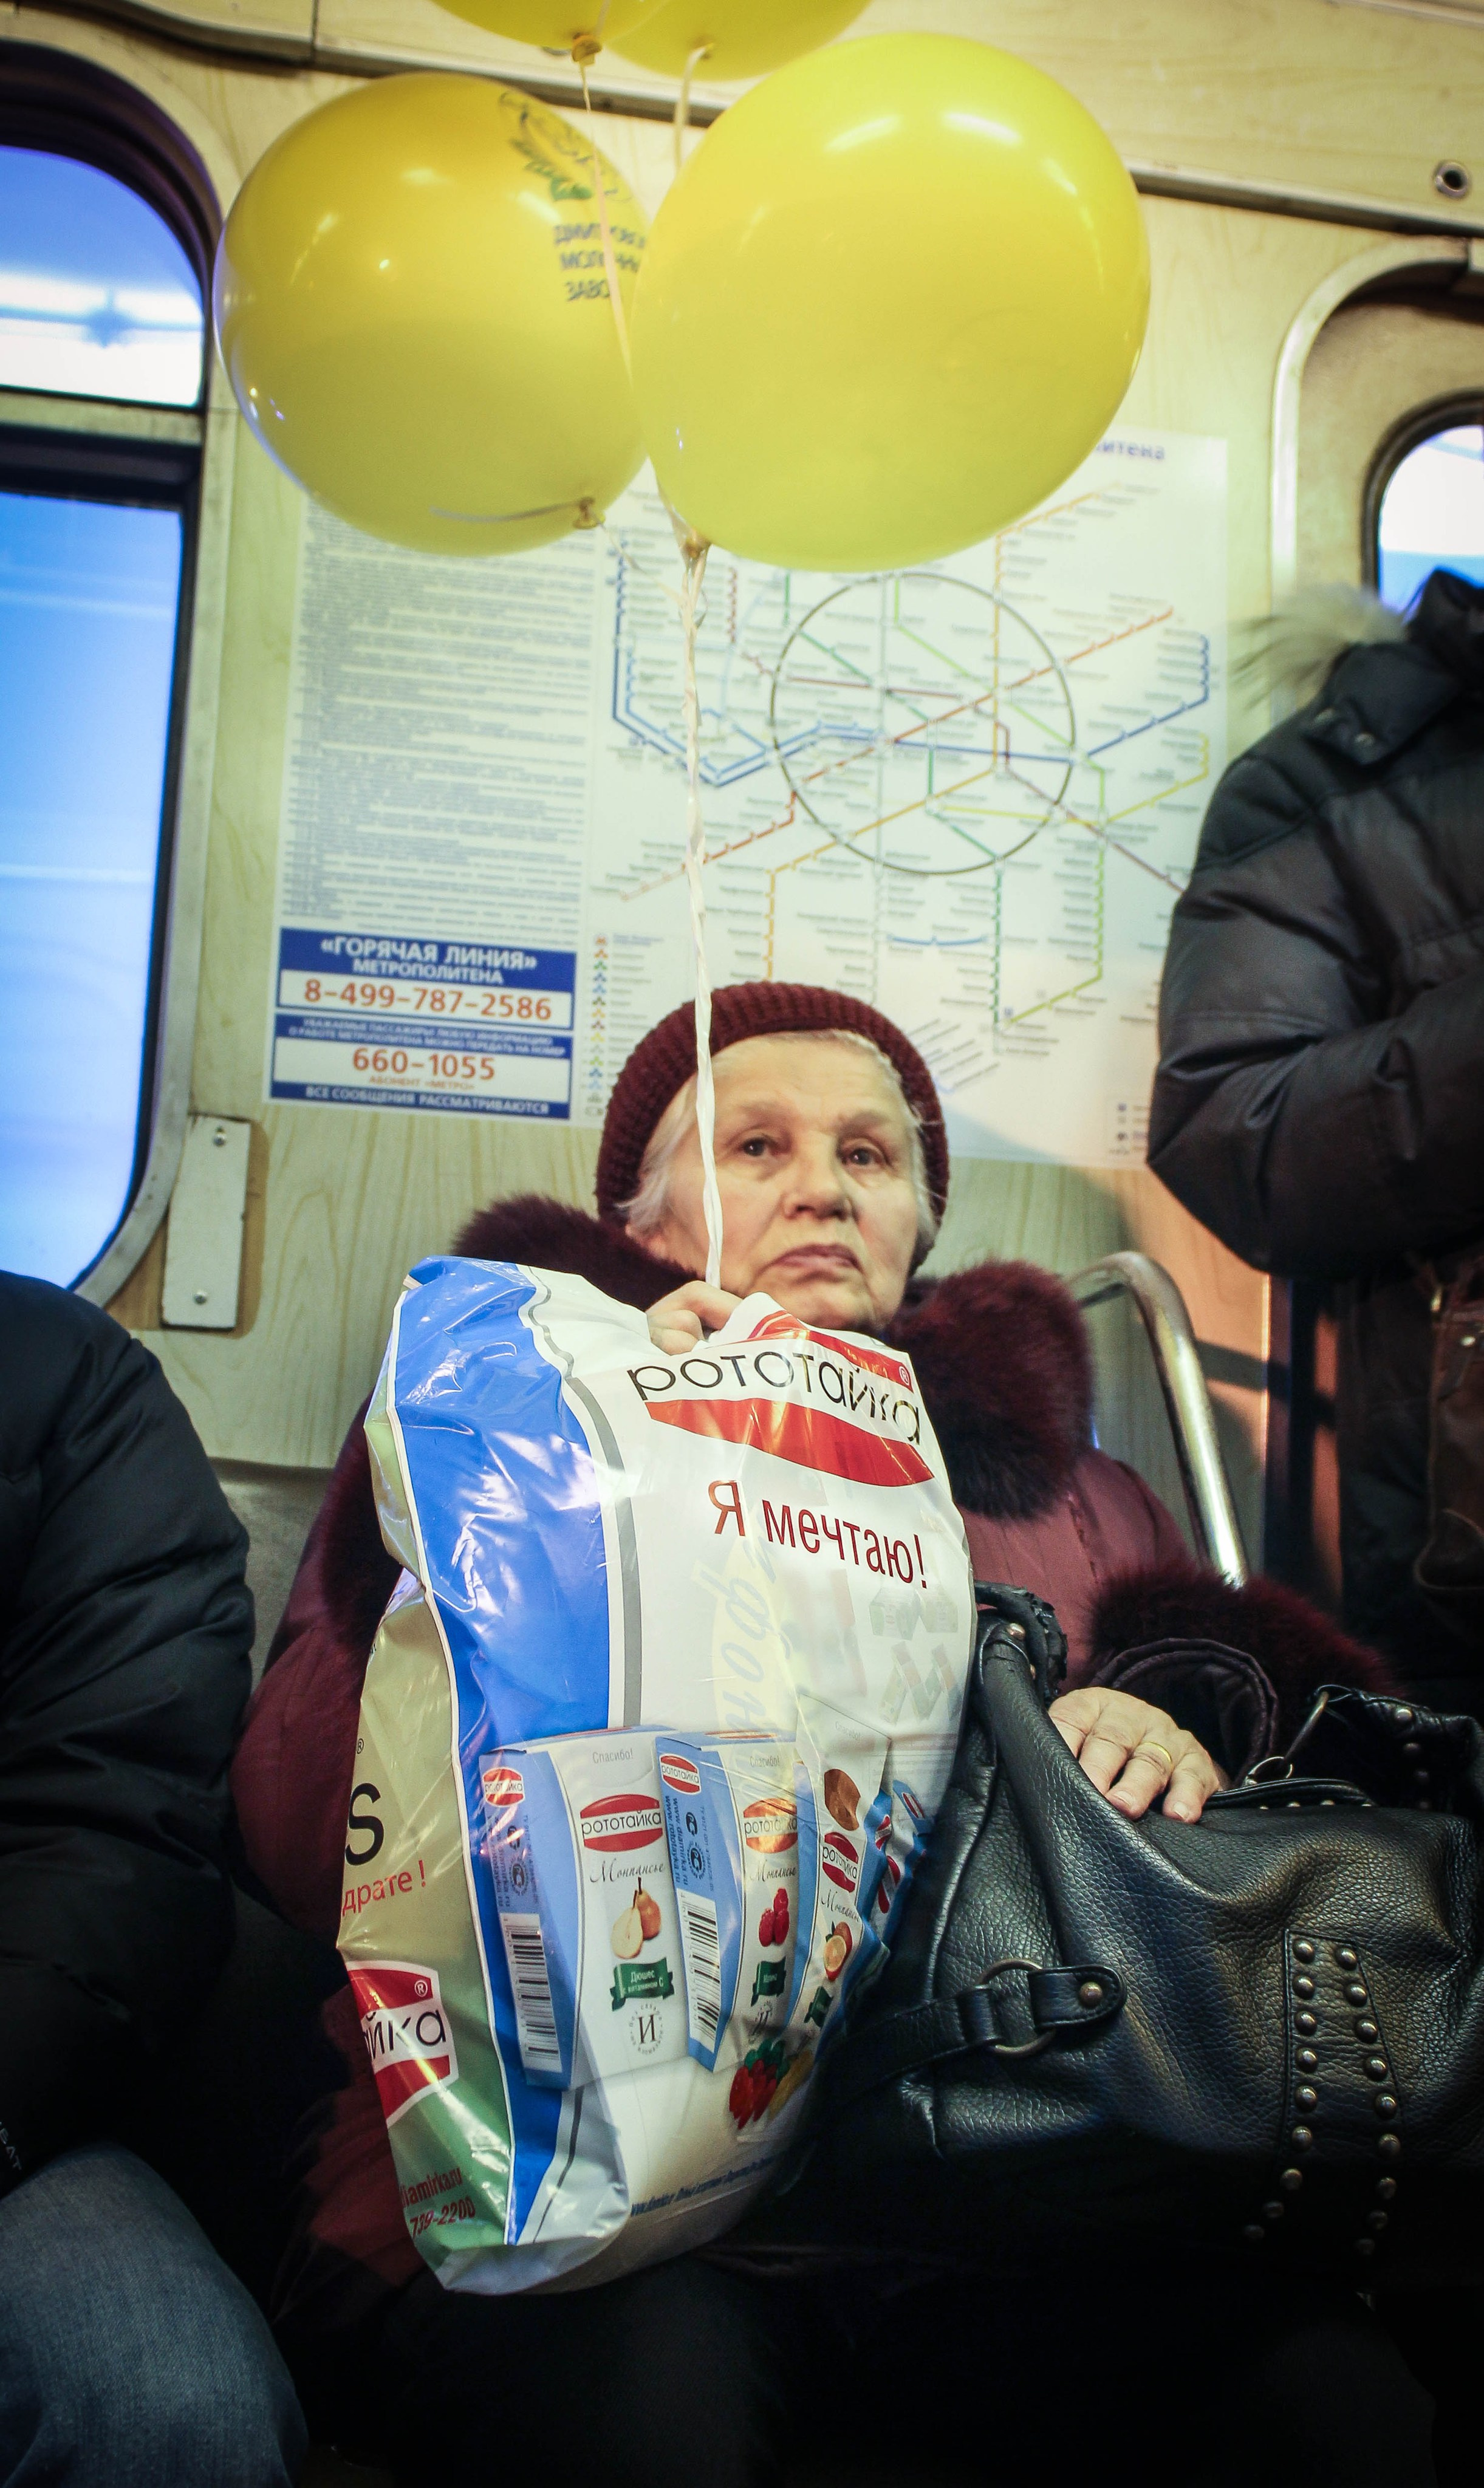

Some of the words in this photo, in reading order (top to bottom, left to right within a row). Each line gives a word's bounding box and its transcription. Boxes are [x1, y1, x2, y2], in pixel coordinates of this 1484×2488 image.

[565, 279, 611, 301] ЗАВО
[1096, 440, 1166, 460] итена
[321, 935, 438, 963] «ГОРЯЧАЯ
[444, 945, 538, 971] ЛИНИЯ»
[353, 958, 504, 985] МЕТРОПОЛИТЕНА
[304, 978, 552, 1021] 8-499-787-2586
[353, 1046, 495, 1081] 660-1055
[305, 1085, 330, 1098] ВСЕ
[332, 1087, 415, 1106] СООБЩЕНИЯ
[419, 1093, 550, 1115] РАССМАТРИВАЮТСЯ
[627, 1351, 921, 1444] рототайка
[708, 1480, 746, 1537] Я
[762, 1499, 928, 1589] мечтаю!
[592, 1748, 634, 1764] Спасибо!
[661, 1764, 700, 1785] рототайка
[581, 1809, 662, 1845] рототайка
[744, 1817, 798, 1844] рототака
[364, 2009, 447, 2060] йка
